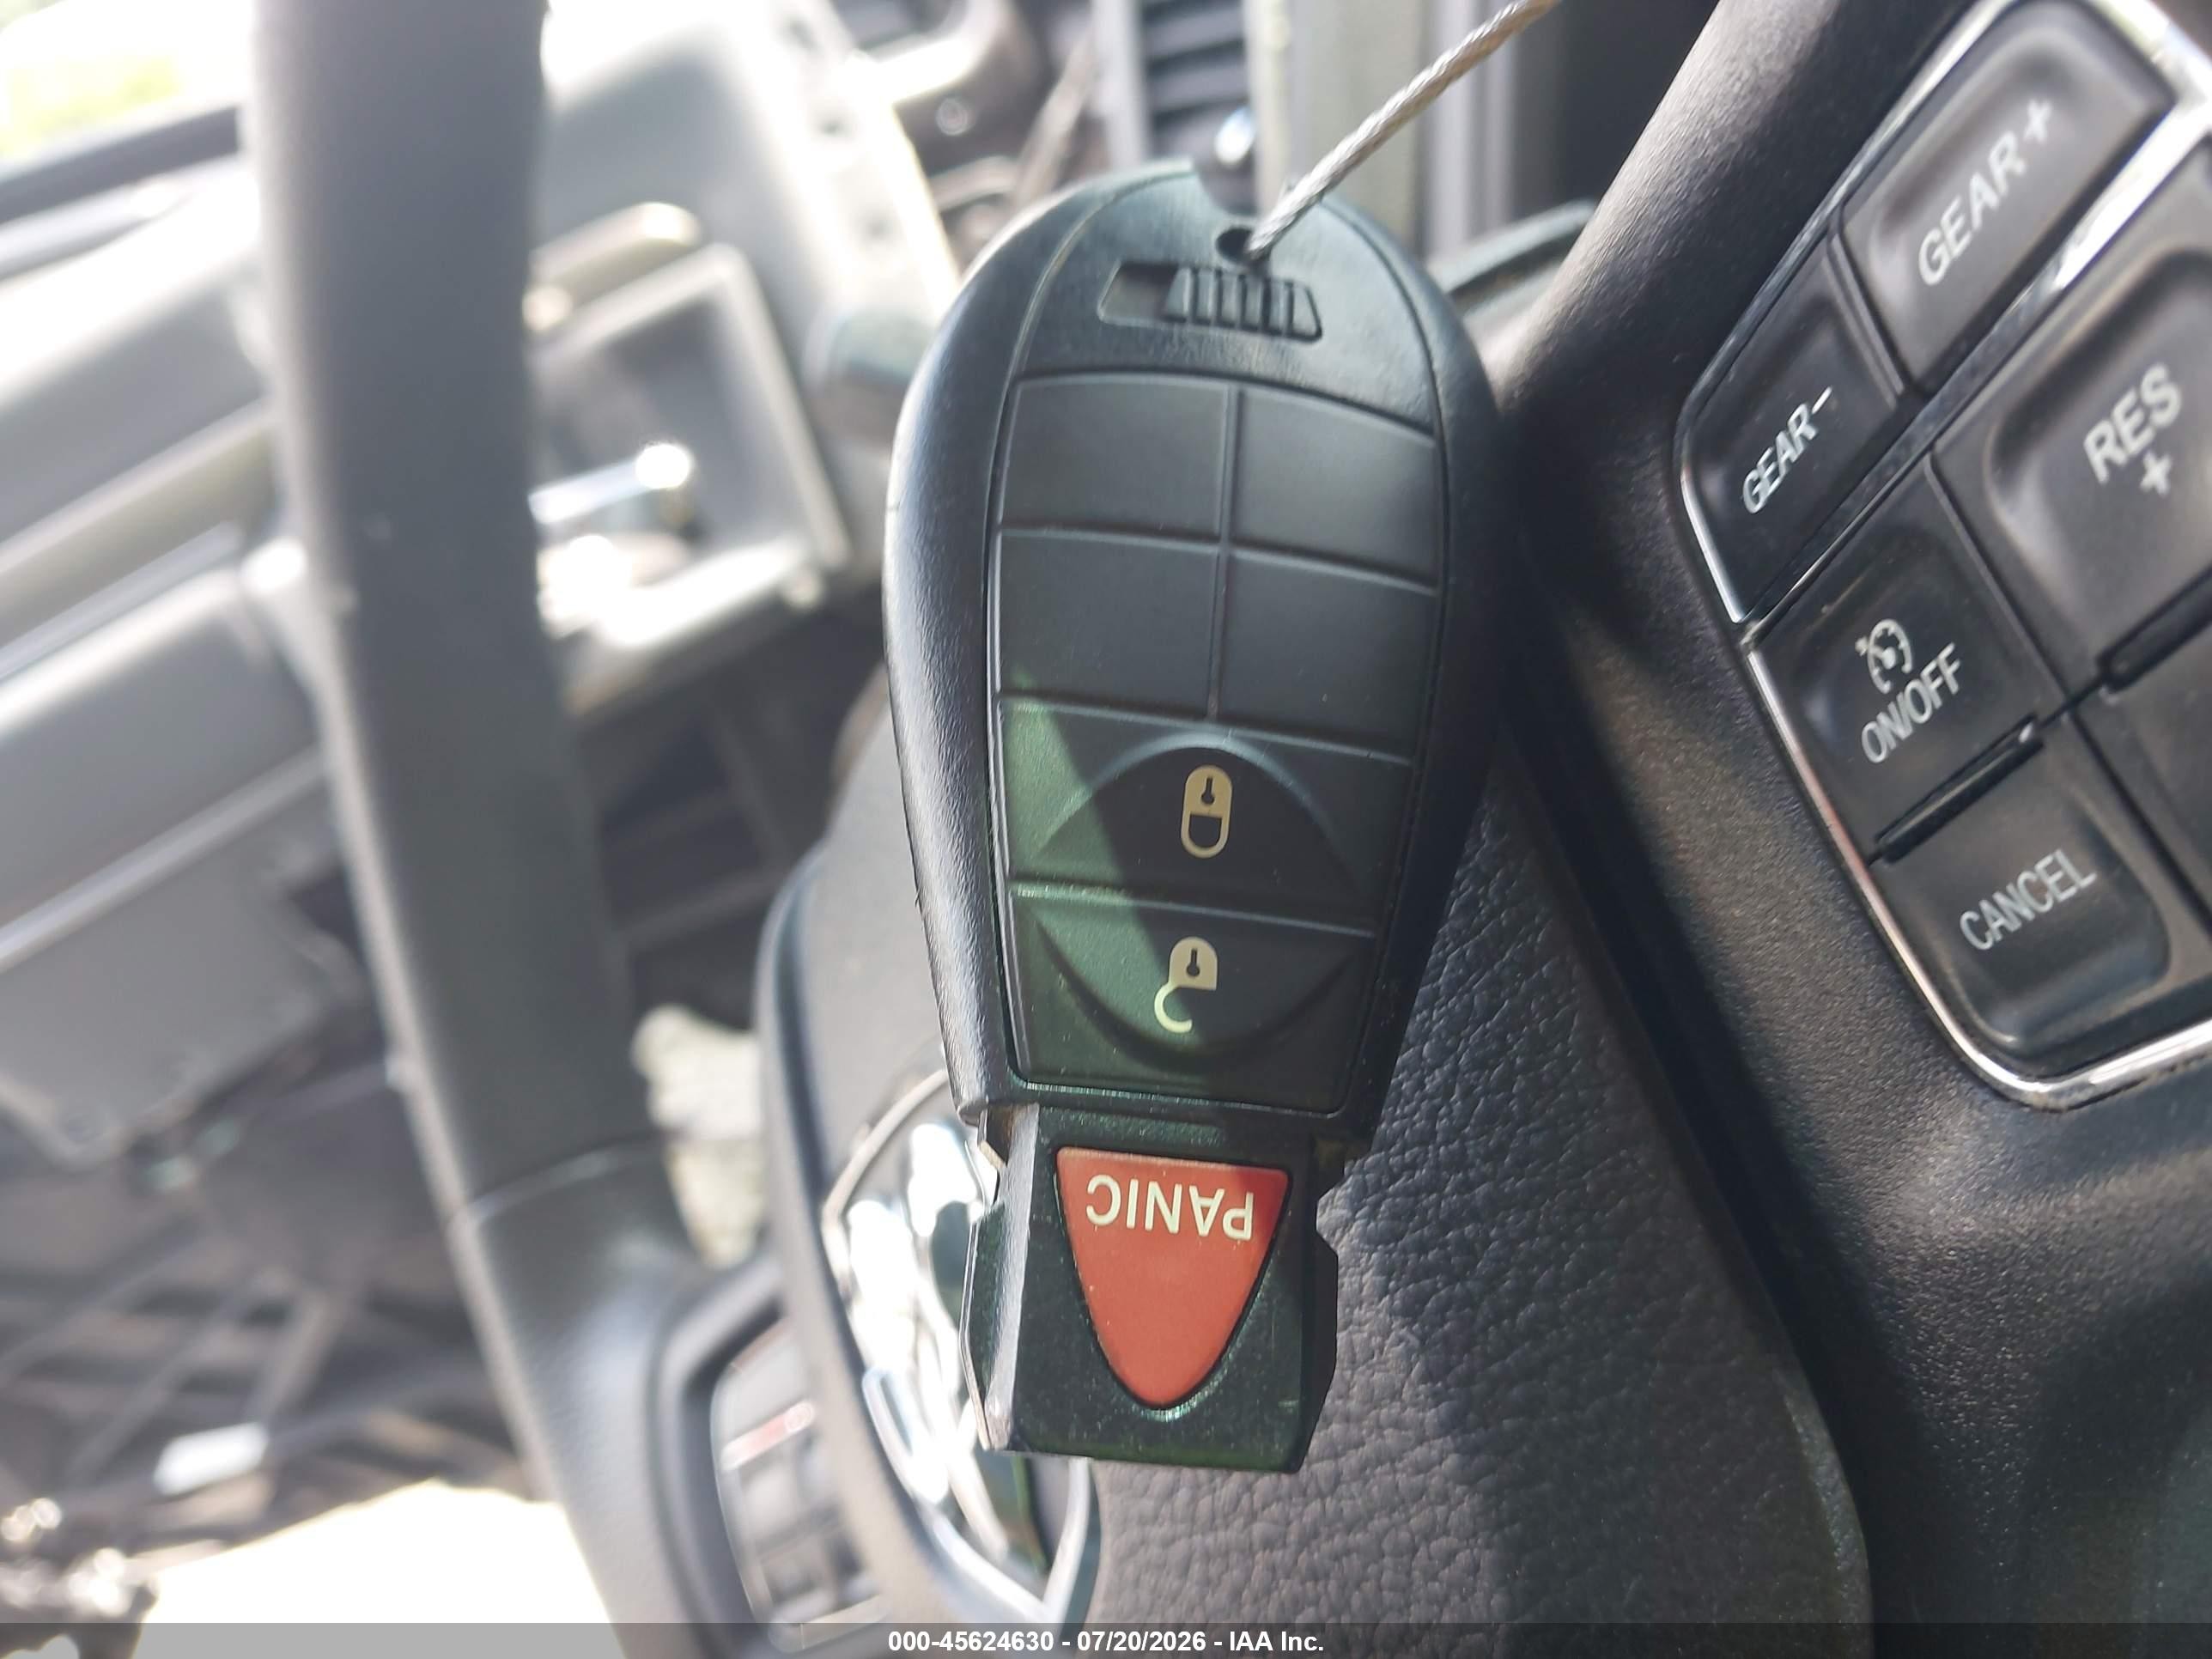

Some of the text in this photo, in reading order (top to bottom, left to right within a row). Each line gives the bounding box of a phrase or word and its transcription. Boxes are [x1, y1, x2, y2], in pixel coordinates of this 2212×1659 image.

[2082, 364, 2183, 483] RES
[1860, 641, 1964, 763] ON/OFF
[1959, 848, 2097, 951] CANCEL
[1085, 1174, 1255, 1241] PANIC
